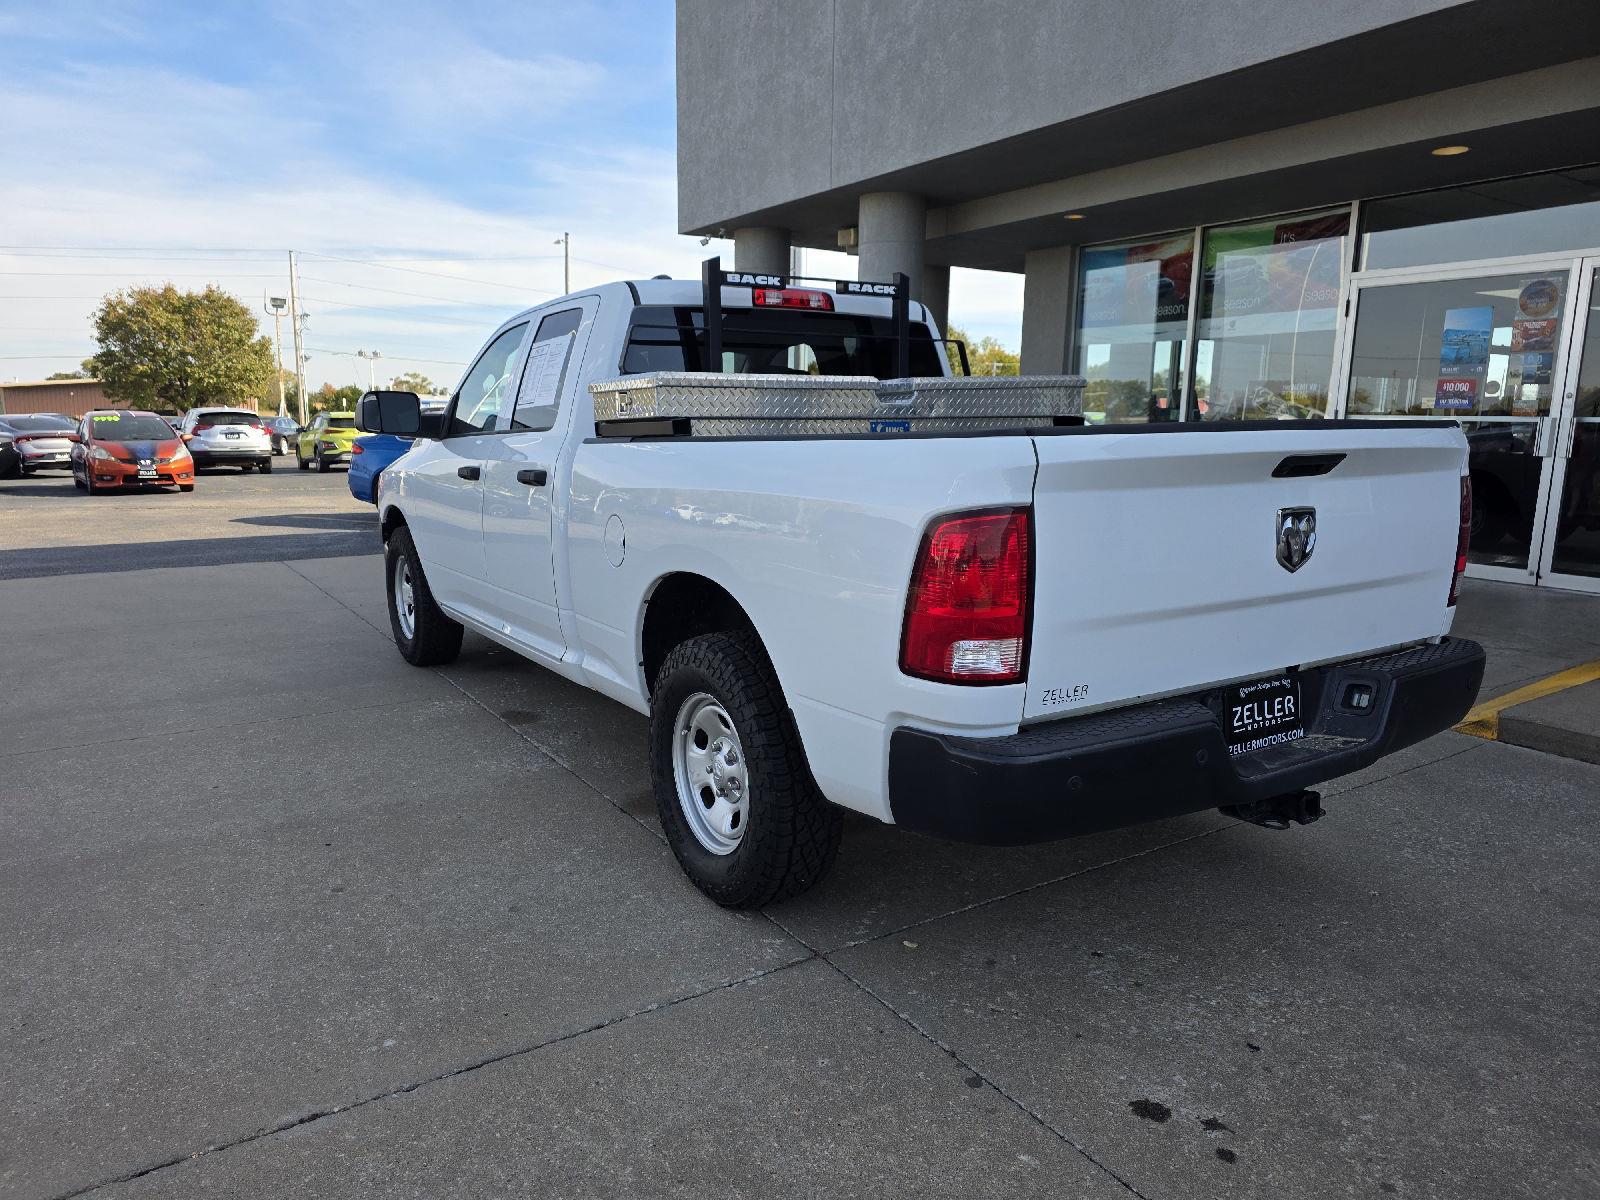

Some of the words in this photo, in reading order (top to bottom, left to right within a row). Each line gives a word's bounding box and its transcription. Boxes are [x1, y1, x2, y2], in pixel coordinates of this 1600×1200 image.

[726, 273, 781, 287] BACK
[848, 282, 897, 295] RACK
[1304, 288, 1339, 303] seaso
[1041, 684, 1089, 702] ZELLER
[1232, 695, 1295, 727] ZELLER
[1247, 717, 1282, 731] MOTORS
[1228, 727, 1304, 756] ZELLERMOTORS.COM
